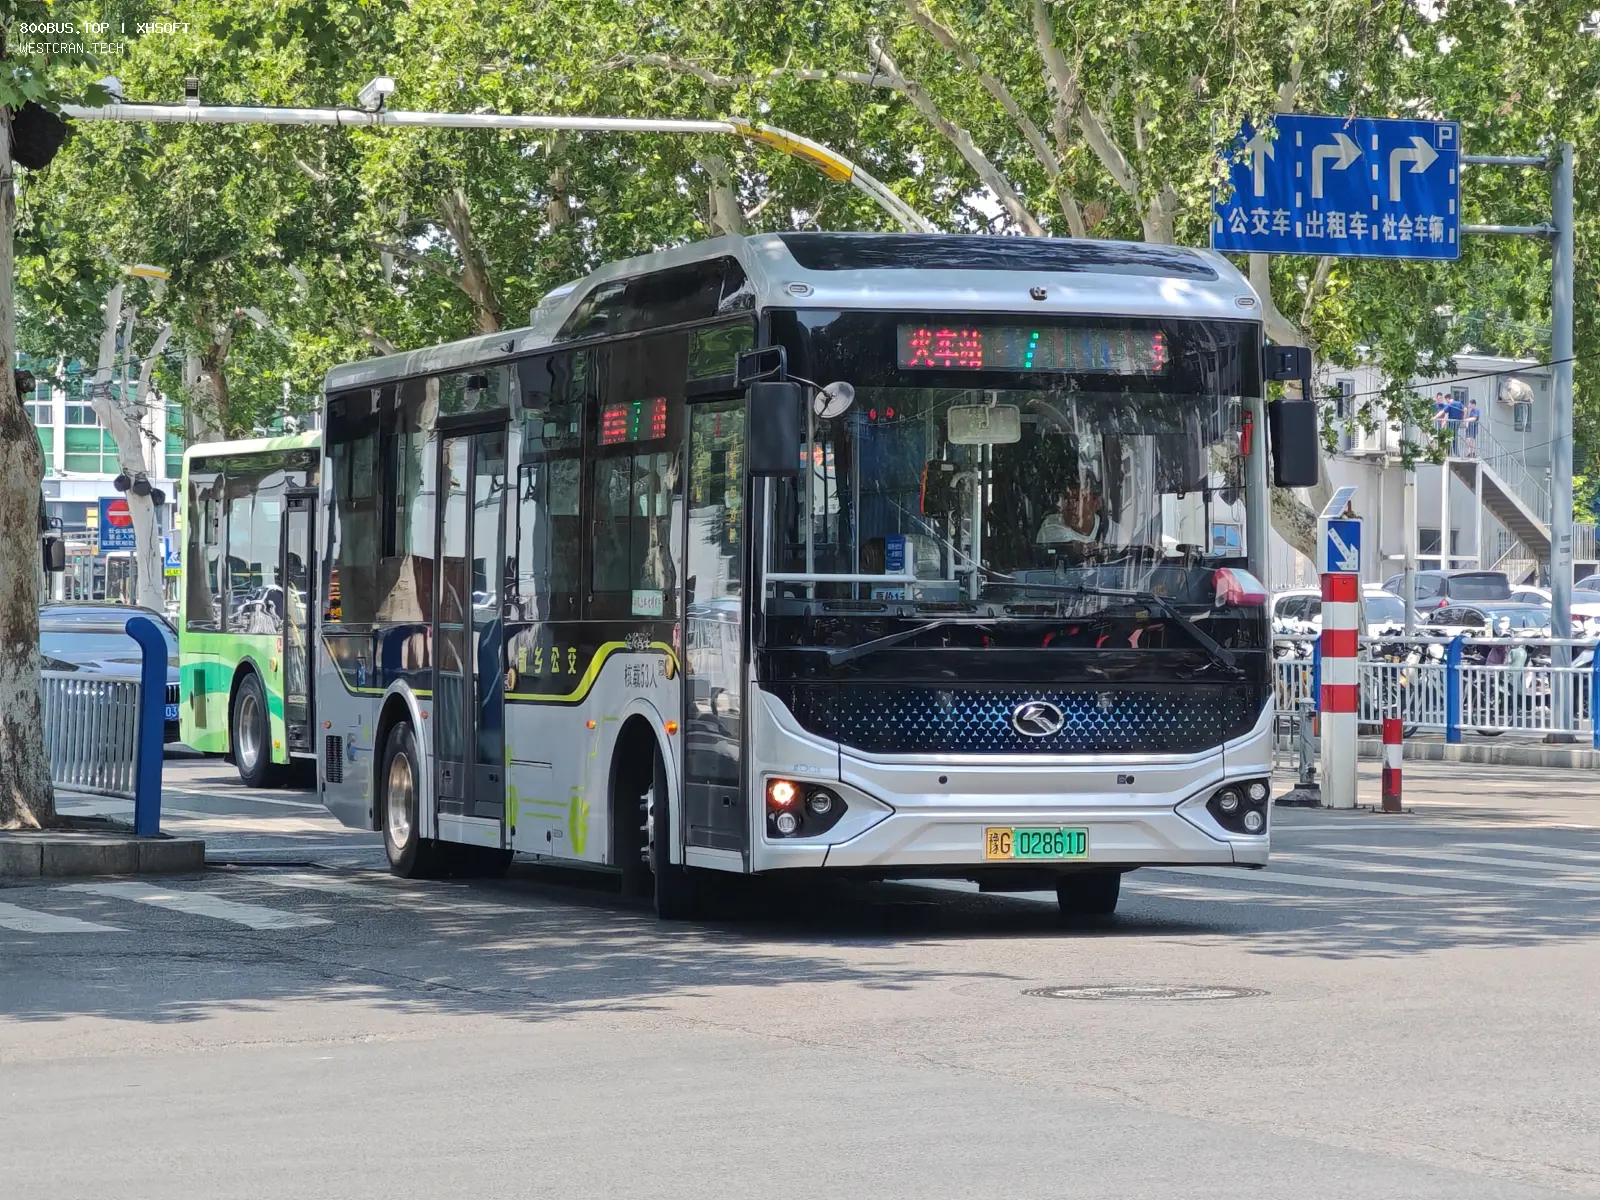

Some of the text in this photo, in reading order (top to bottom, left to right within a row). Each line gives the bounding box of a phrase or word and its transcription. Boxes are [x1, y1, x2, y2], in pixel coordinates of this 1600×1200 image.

[1438, 126, 1453, 148] P
[1228, 206, 1291, 236] 公交车
[1305, 210, 1369, 240] 出租车
[1381, 213, 1445, 243] 社会车辆
